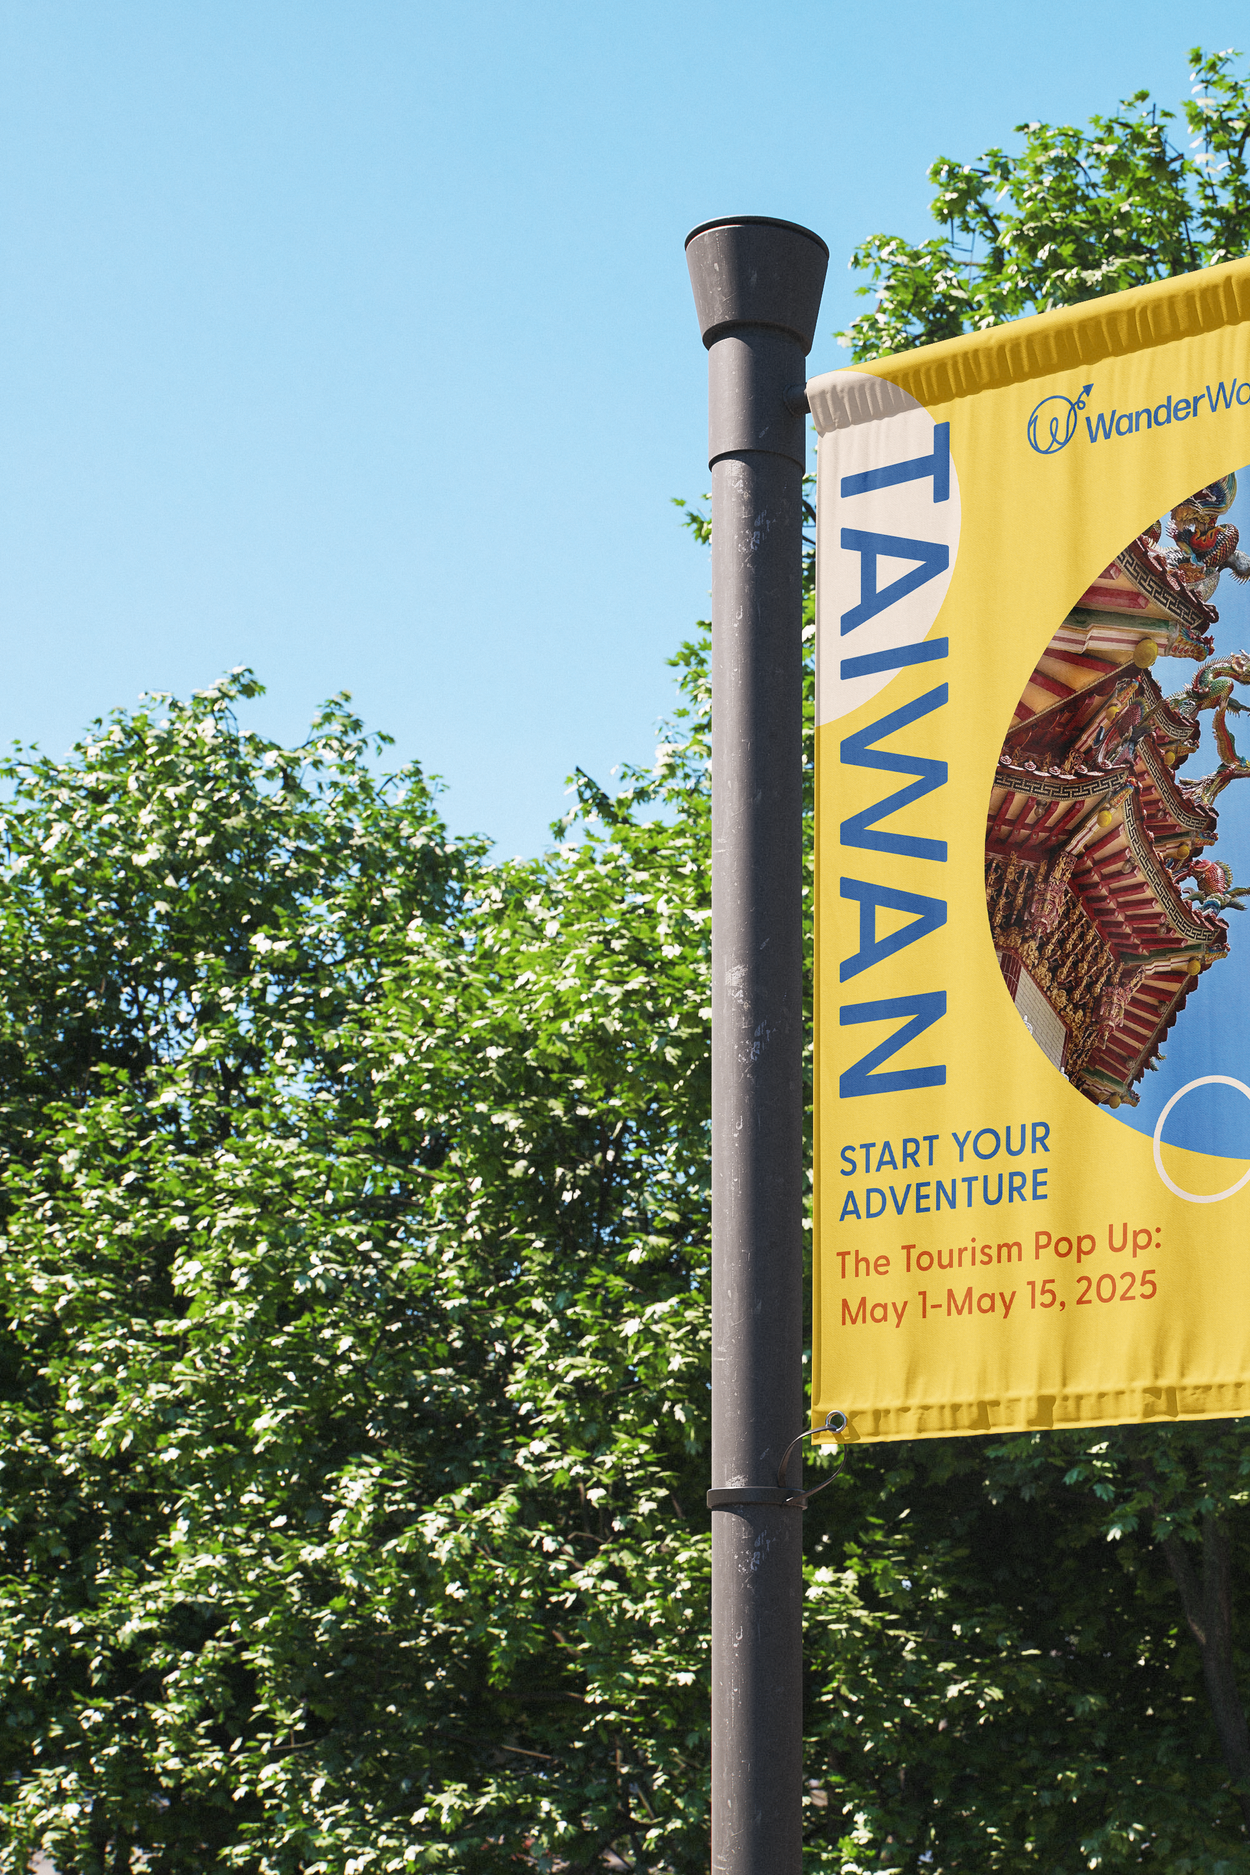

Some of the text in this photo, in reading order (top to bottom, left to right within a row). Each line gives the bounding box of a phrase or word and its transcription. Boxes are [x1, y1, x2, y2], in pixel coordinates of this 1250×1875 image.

[839, 421, 950, 1099] TAIWAN
[840, 1121, 1050, 1176] START YOUR
[839, 1168, 1048, 1222] ADVENTURE
[836, 1222, 1162, 1279] The Tourism Pop Up:
[841, 1269, 1158, 1328] May 1-May 15, 2025
